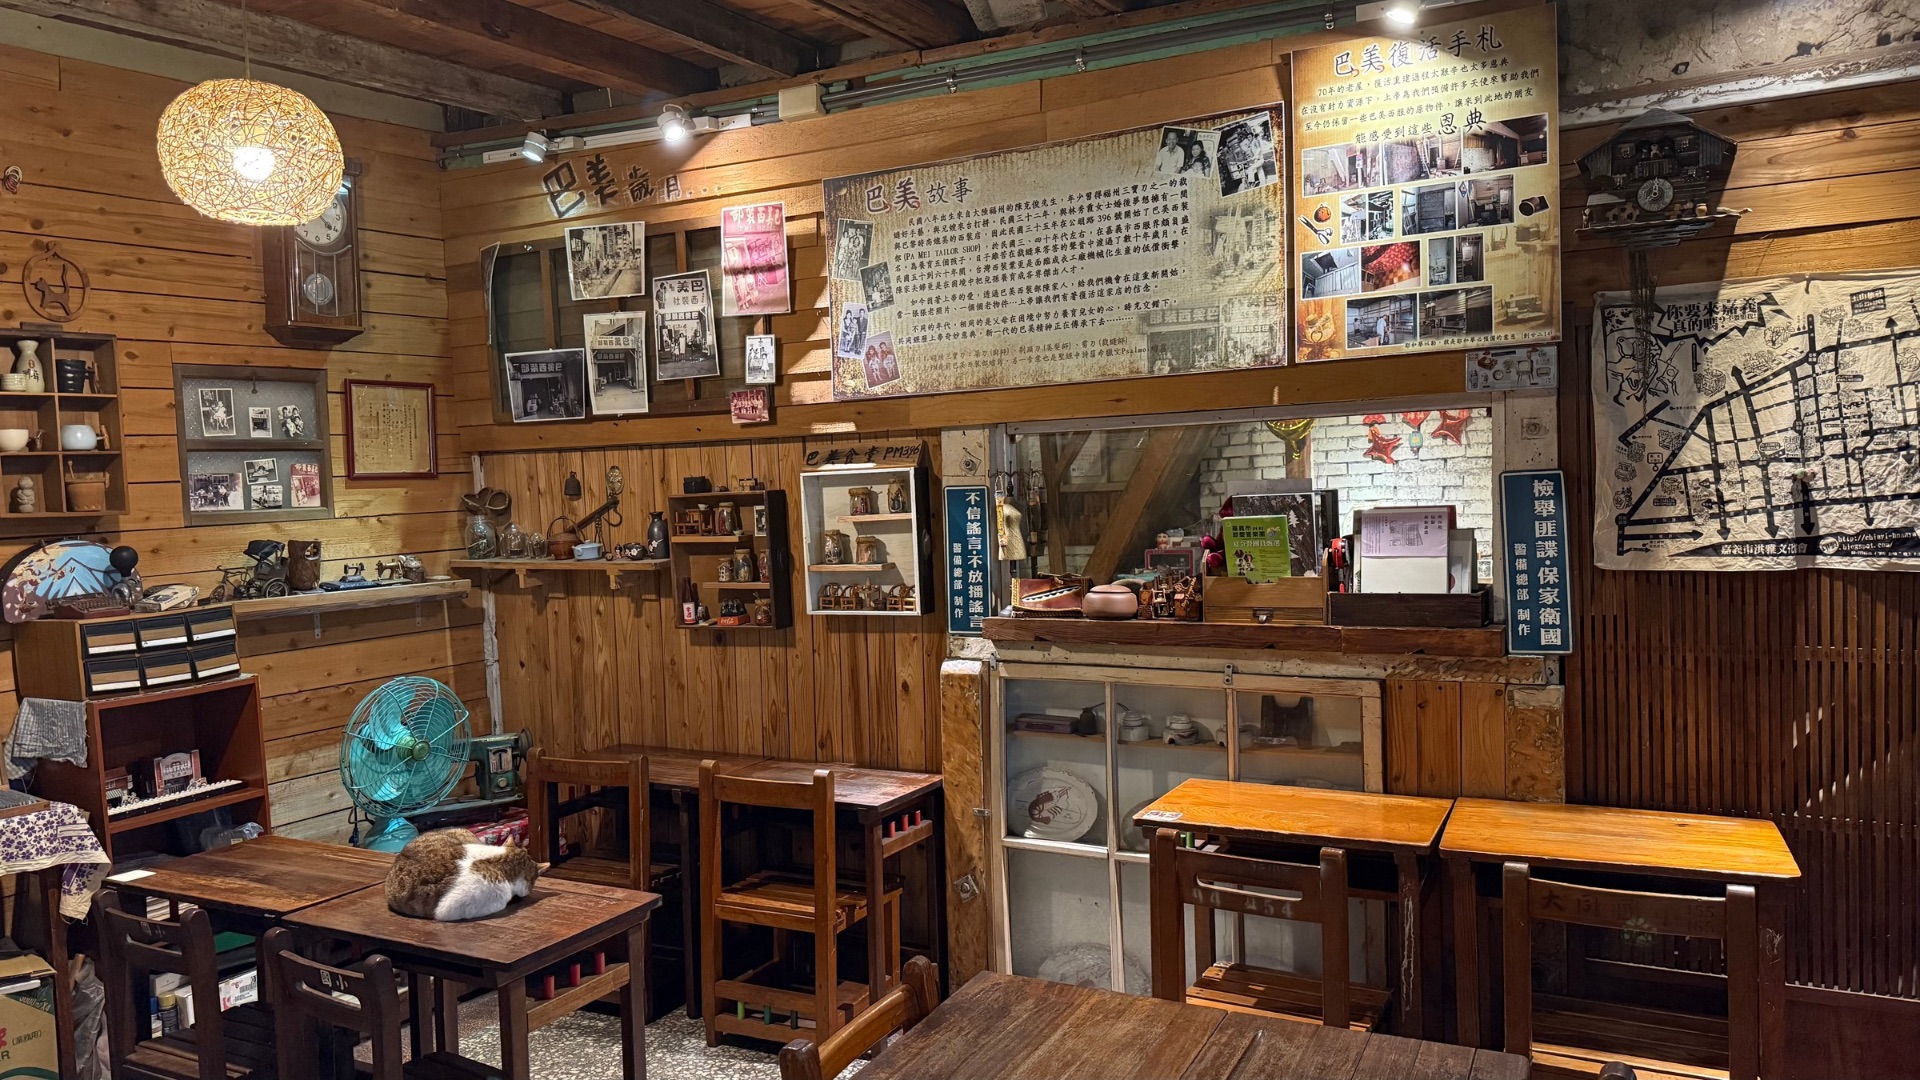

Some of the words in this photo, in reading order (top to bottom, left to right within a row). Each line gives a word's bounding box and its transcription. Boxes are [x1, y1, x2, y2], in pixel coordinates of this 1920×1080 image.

[1334, 25, 1502, 77] 巴美復活手札
[1356, 108, 1487, 145] 能感受到這些恩典
[864, 176, 973, 215] 巴美故事
[1097, 213, 1111, 222] 396
[917, 250, 930, 259] MEI
[935, 246, 958, 256] TAILOR
[676, 279, 705, 293] 巴美
[806, 445, 880, 466] 巴美食堂
[882, 443, 922, 461] PM396
[952, 542, 964, 590] 警備總部
[1513, 542, 1530, 601] 警備總部
[1517, 608, 1531, 636] 制作
